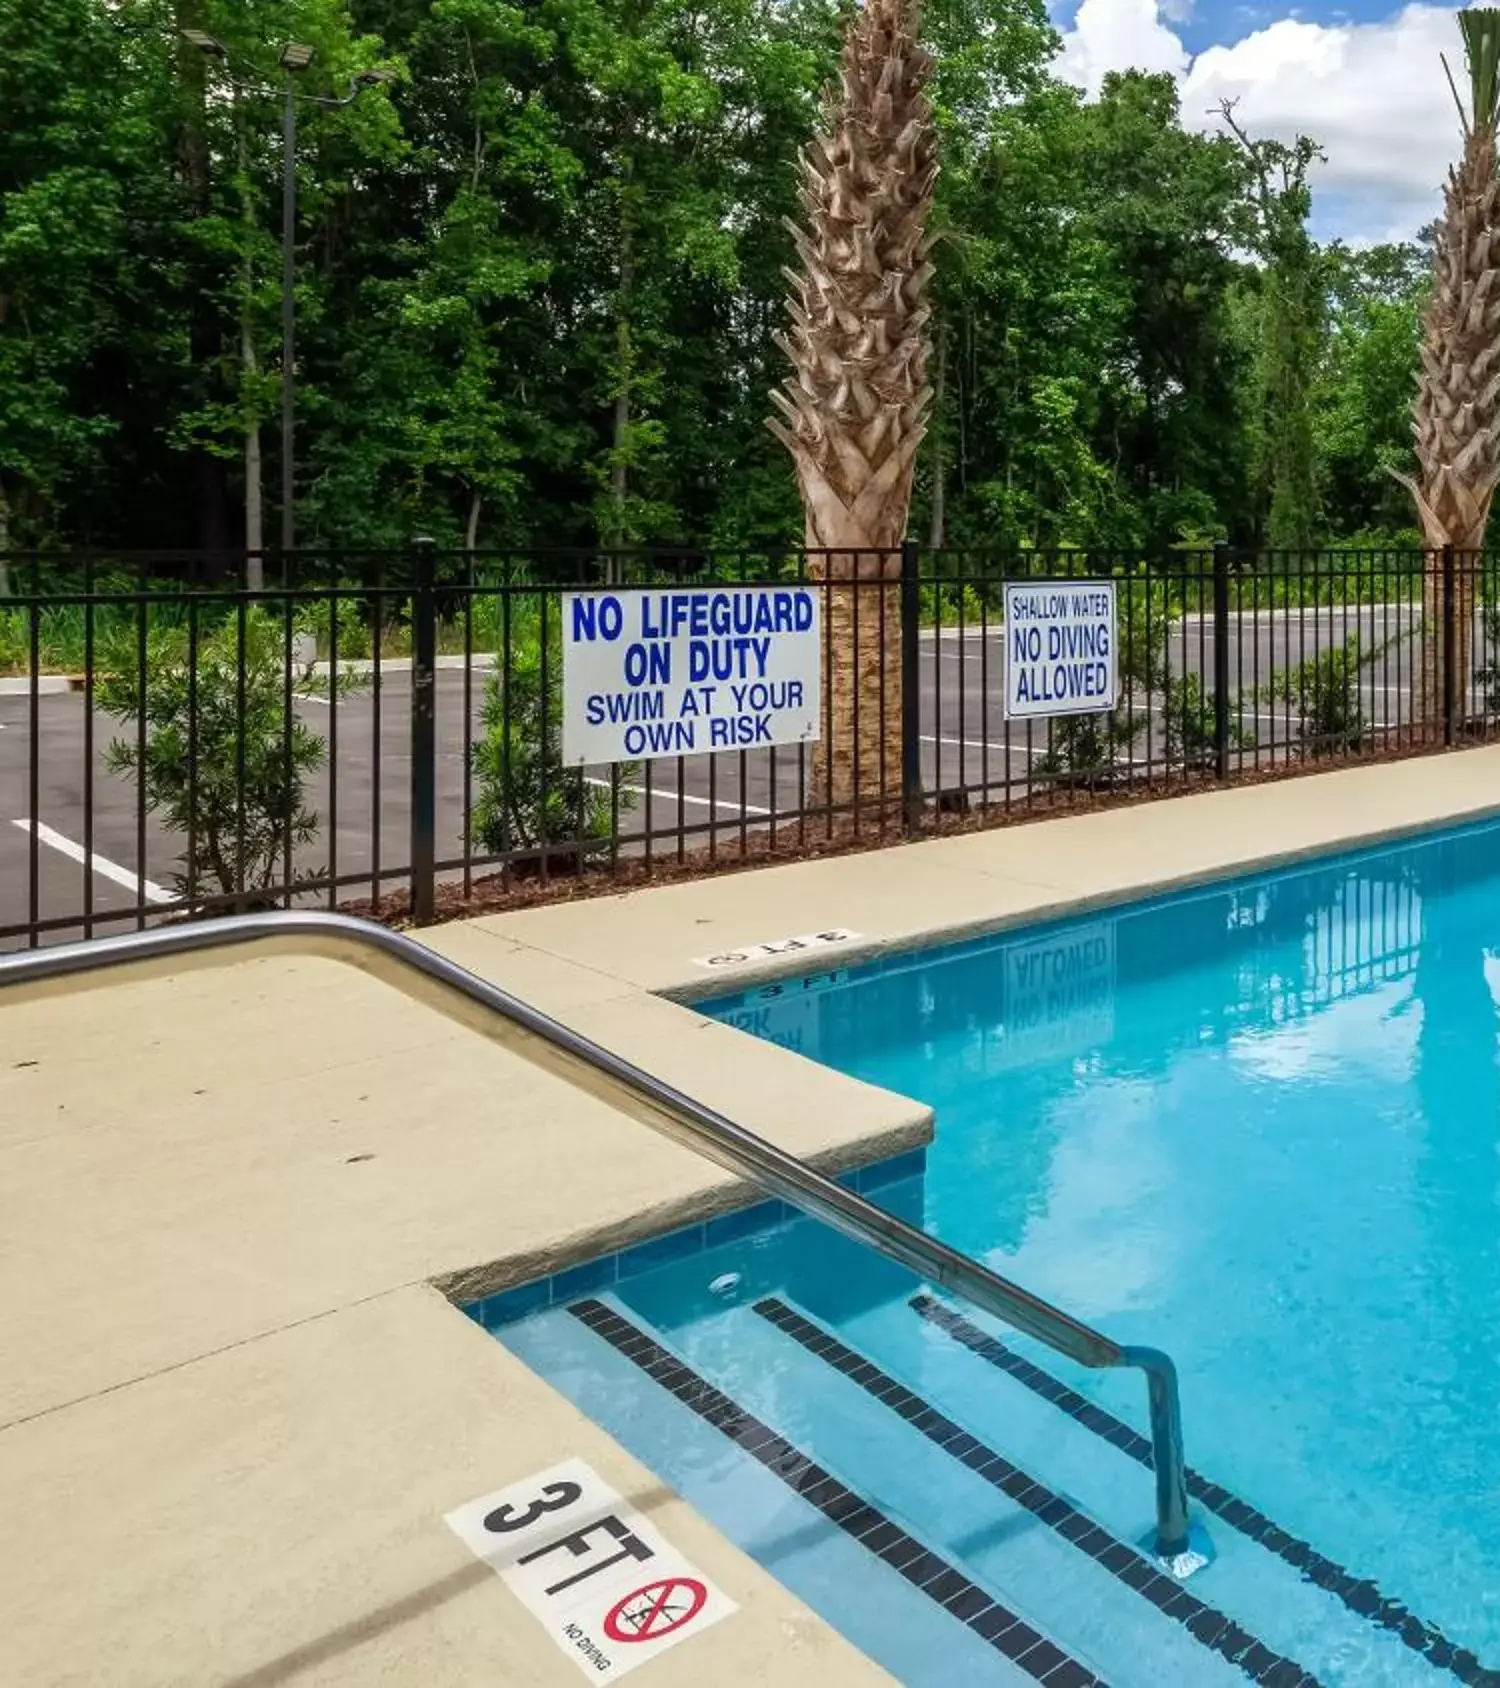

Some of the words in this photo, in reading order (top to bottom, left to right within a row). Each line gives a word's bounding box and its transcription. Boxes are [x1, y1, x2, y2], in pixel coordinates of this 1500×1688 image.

[573, 595, 623, 642] NO
[641, 592, 813, 639] LIFEGUARD
[1013, 595, 1069, 620] SHALLOW
[1071, 593, 1109, 617] WATER
[624, 641, 671, 686] ON
[689, 637, 771, 682] DUTY
[1014, 626, 1041, 662] NO
[1049, 623, 1109, 660] DIVING
[586, 690, 664, 725] SWIM
[679, 687, 717, 717] AT
[731, 681, 803, 713] YOUR
[1016, 662, 1107, 702] ALLOWED
[624, 720, 694, 755] OWN
[710, 714, 772, 747] RISK
[760, 984, 784, 998] 3
[803, 970, 843, 988] FT
[483, 1481, 583, 1533] 3
[516, 1515, 655, 1596] FT
[563, 1623, 582, 1640] NO
[576, 1633, 611, 1672] DIVING
